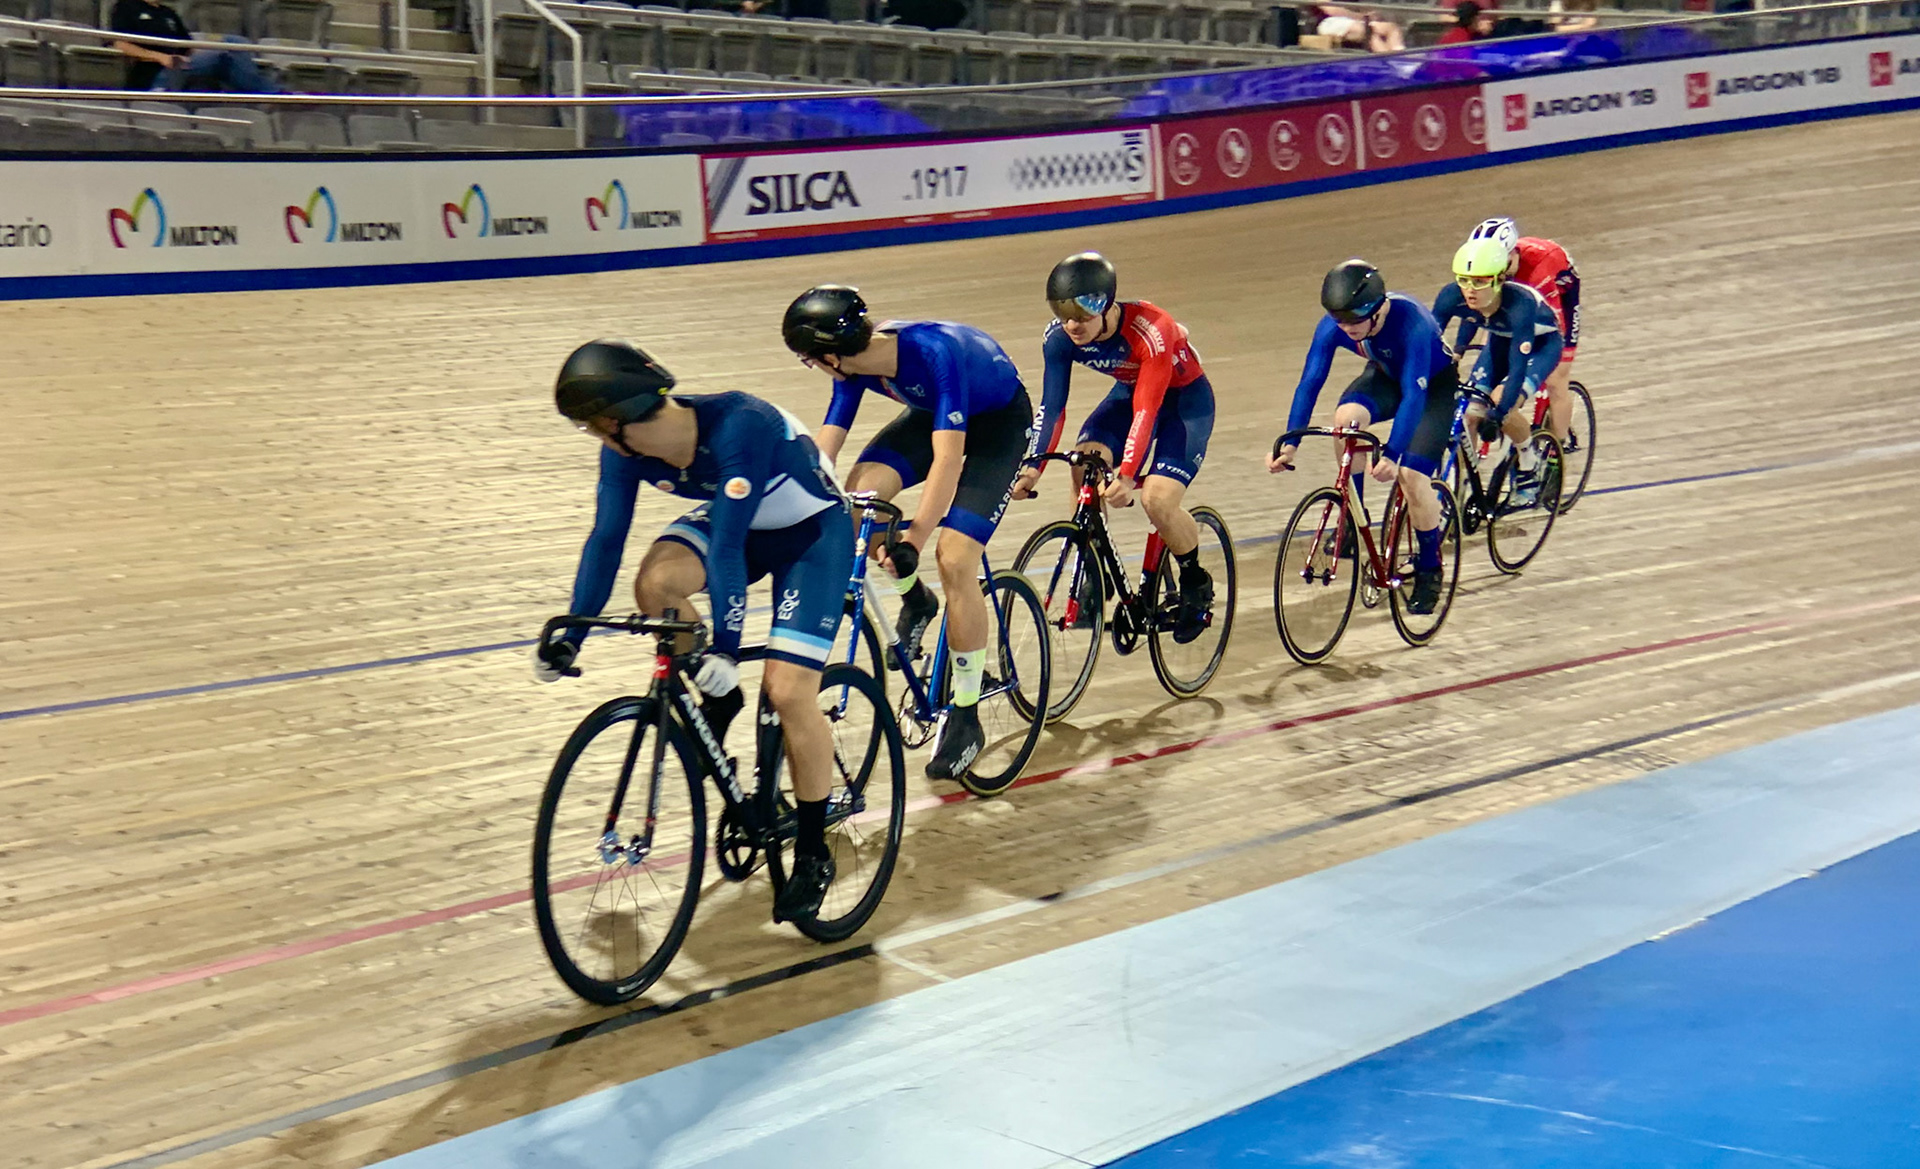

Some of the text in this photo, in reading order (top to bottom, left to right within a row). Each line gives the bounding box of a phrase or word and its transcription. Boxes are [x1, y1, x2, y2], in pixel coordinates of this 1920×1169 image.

[1715, 67, 1841, 96] ARGON 18
[1532, 88, 1657, 118] ARGON 18
[745, 171, 861, 215] SILCA
[341, 222, 402, 241] MILTON
[492, 216, 548, 236] MILTON
[631, 210, 682, 229] MILTON
[170, 226, 238, 246] MILTON
[1032, 405, 1046, 430] KW
[1122, 438, 1136, 464] KW
[777, 589, 800, 620] EQC
[680, 694, 732, 779] ARGON
